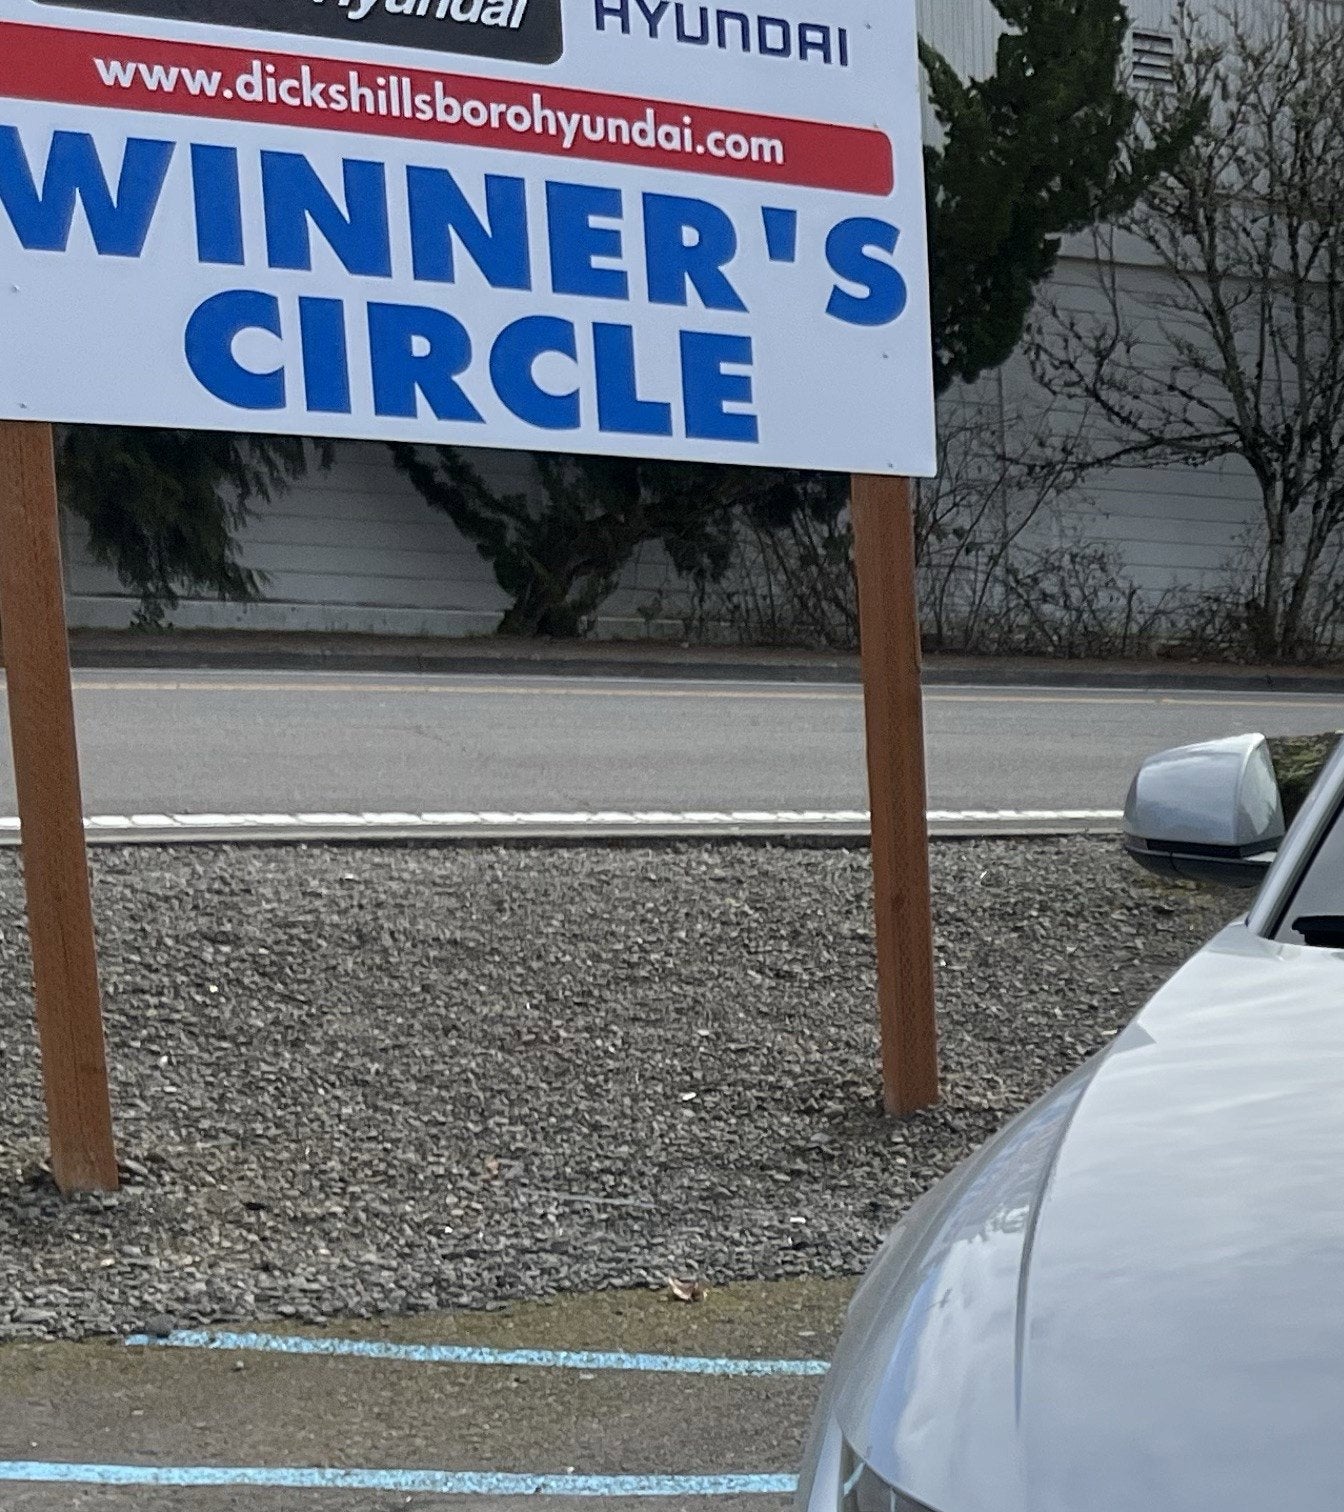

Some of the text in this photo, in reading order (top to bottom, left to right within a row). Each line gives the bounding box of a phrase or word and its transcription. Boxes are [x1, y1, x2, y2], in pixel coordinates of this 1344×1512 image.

[314, 0, 528, 28] yundai
[594, 0, 849, 66] HYUNDAI
[94, 54, 785, 166] www.dickshillsborohyundai.com
[0, 125, 907, 327] WINNER'S
[184, 289, 760, 444] CIRCLE
